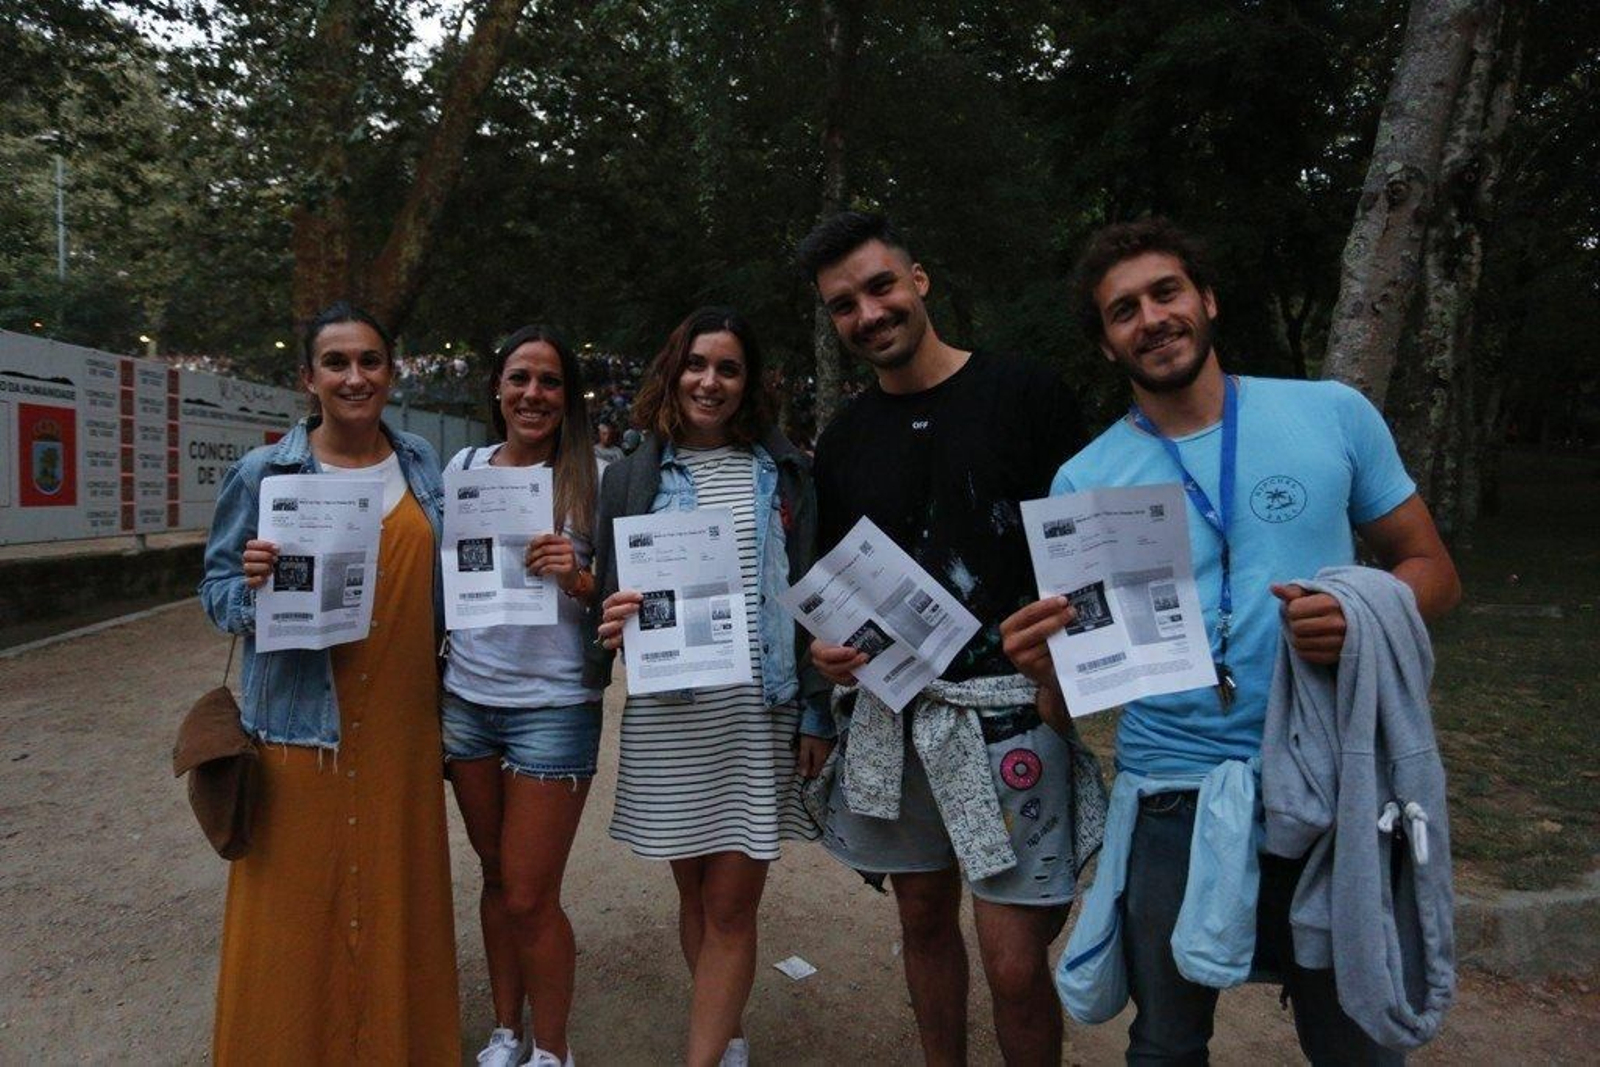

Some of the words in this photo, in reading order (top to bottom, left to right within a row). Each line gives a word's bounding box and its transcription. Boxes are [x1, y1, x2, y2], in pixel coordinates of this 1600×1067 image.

[912, 421, 928, 429] OFF
[189, 441, 255, 461] CONCELL
[198, 467, 215, 484] DE
